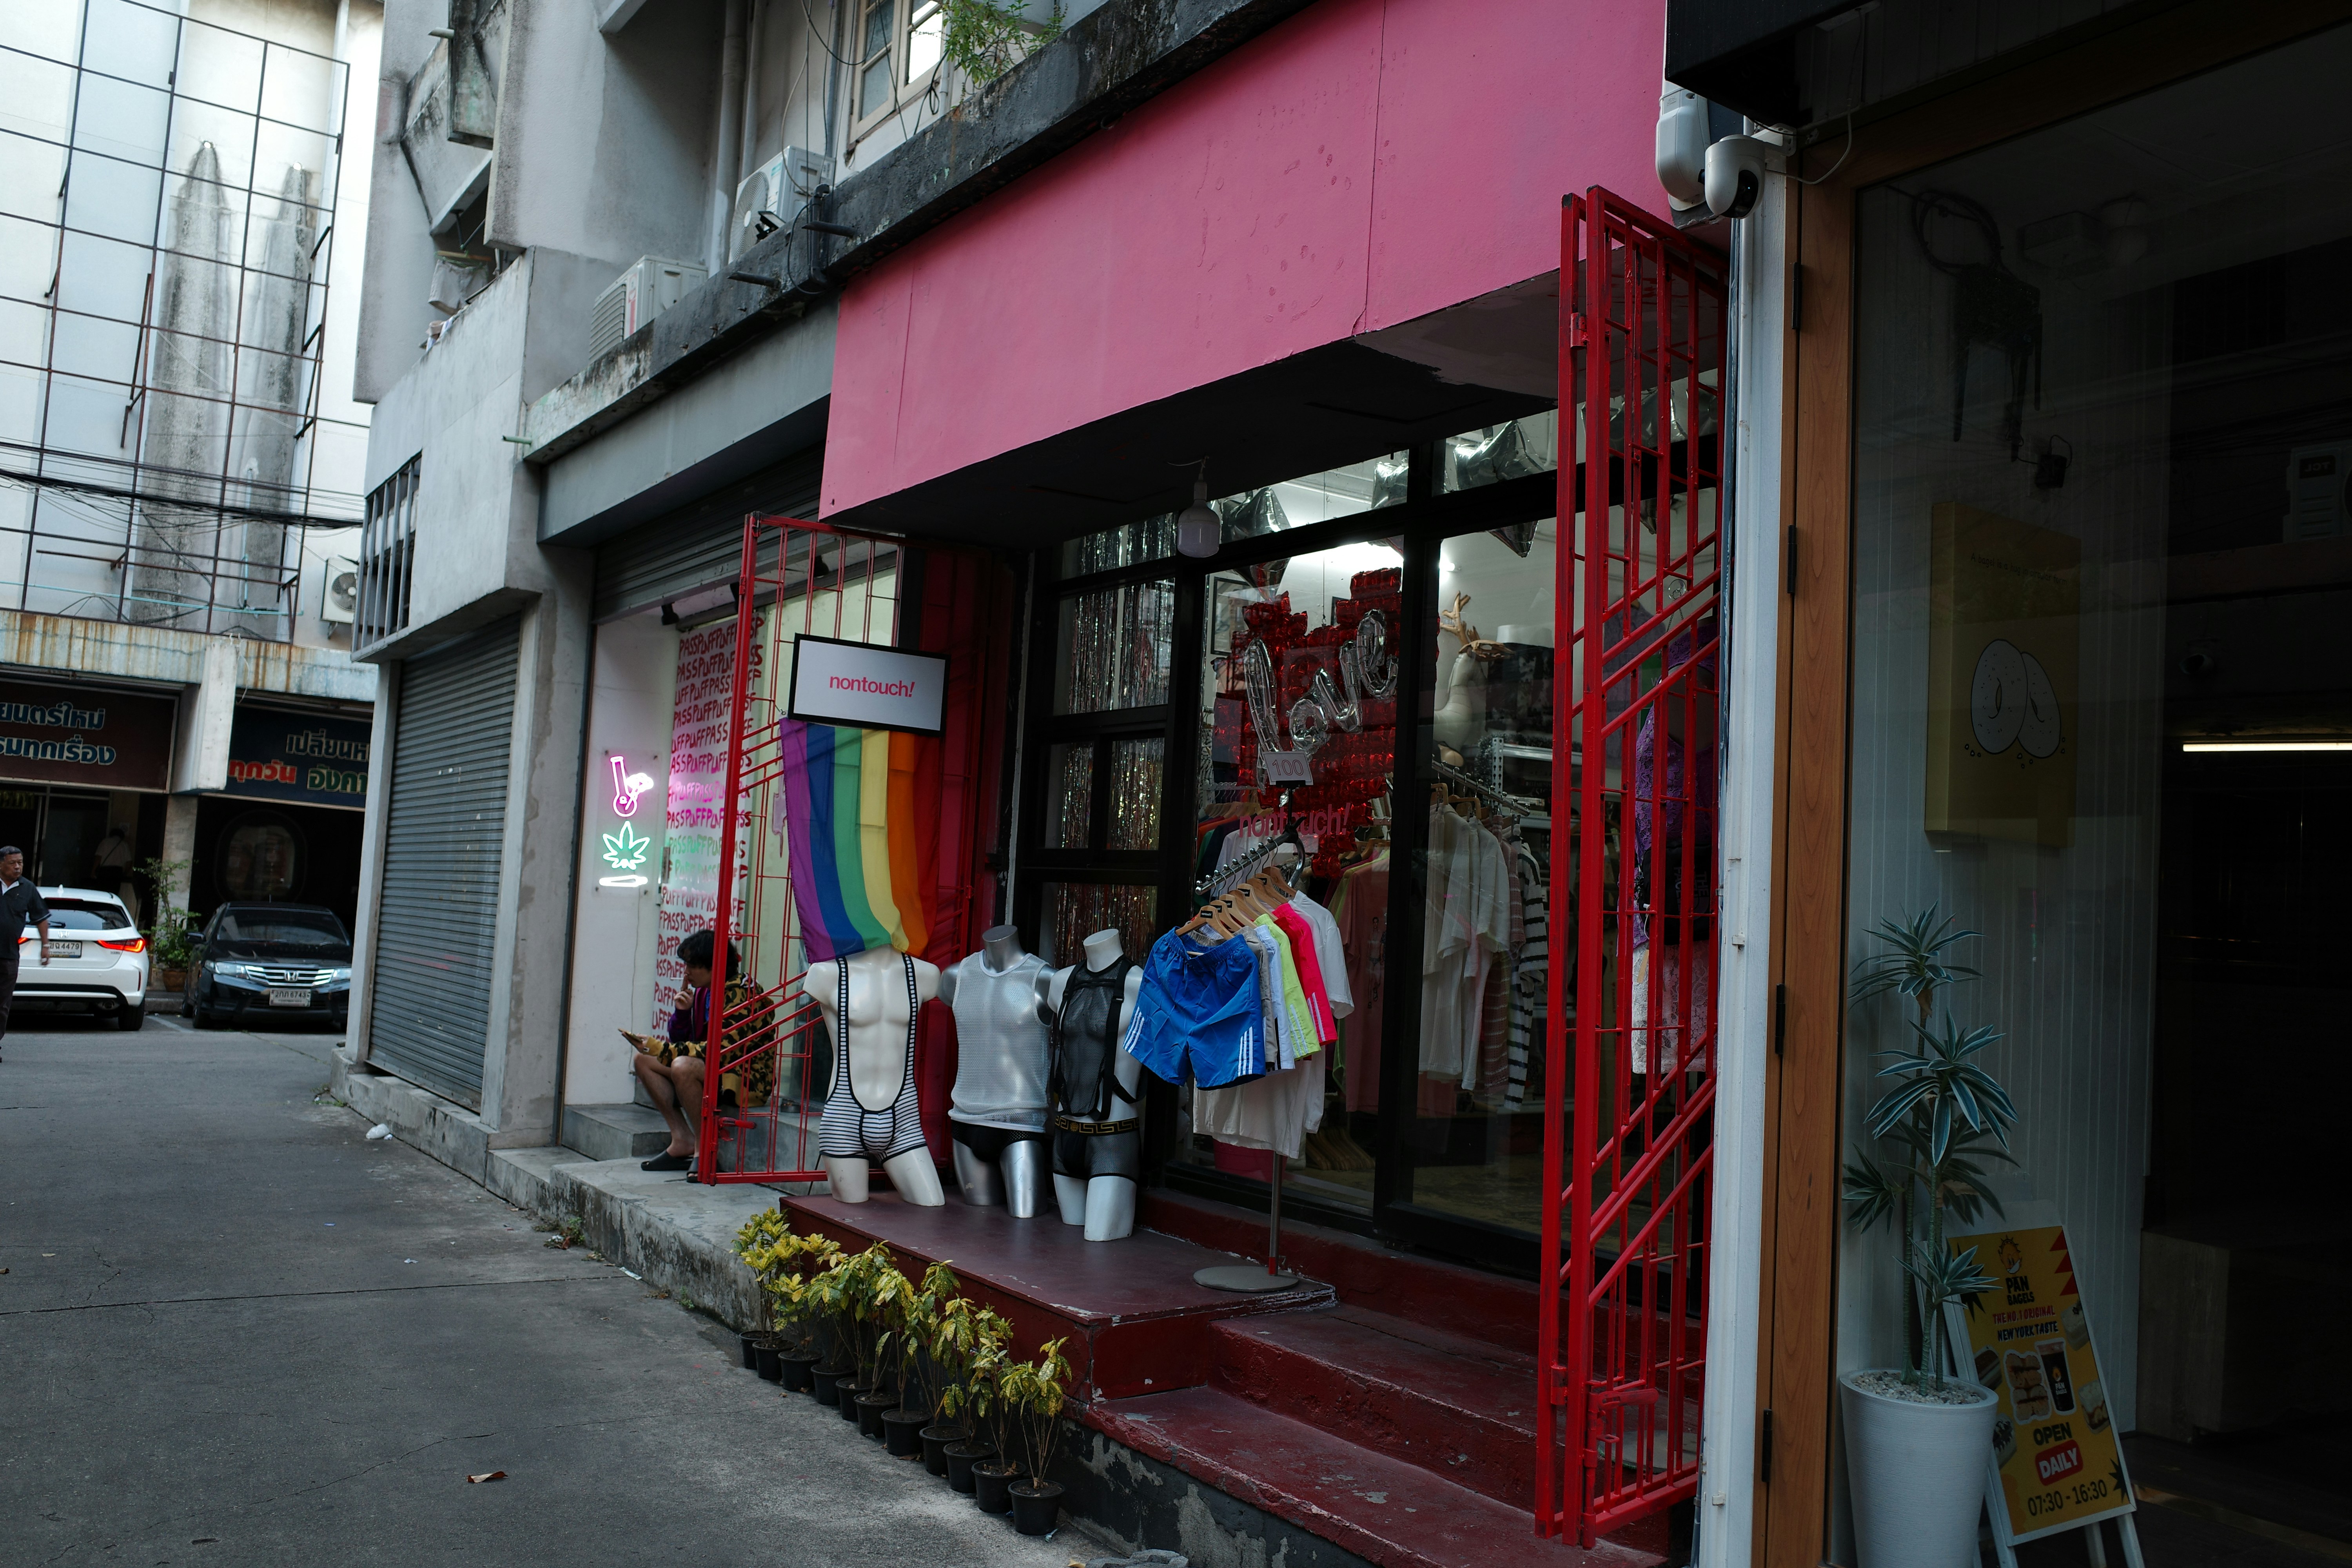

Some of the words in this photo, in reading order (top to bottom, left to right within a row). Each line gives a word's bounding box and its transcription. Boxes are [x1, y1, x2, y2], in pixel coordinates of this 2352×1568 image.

[1971, 553, 1976, 562] A
[1978, 554, 1994, 568] bagel
[1997, 559, 2002, 568] is
[2011, 563, 2020, 576] hug
[2023, 567, 2028, 575] in
[2053, 574, 2068, 586] form
[829, 676, 915, 698] nontouch!
[285, 728, 370, 762] เปลี่ยนห
[228, 759, 298, 784] ทุกวัน
[1272, 759, 1304, 776] 100
[2007, 1291, 2035, 1306] BAGELS
[1992, 1312, 2007, 1325] THE
[2024, 1305, 2056, 1320] ORIGINAL
[1997, 1328, 2014, 1342] NEW
[2014, 1325, 2035, 1339] YORK
[2034, 1321, 2059, 1335] TASTE
[2033, 1422, 2073, 1446] OPEN
[2038, 1448, 2079, 1479] DAILY
[2028, 1490, 2063, 1517] 07:30
[2072, 1479, 2107, 1505] 16:30
